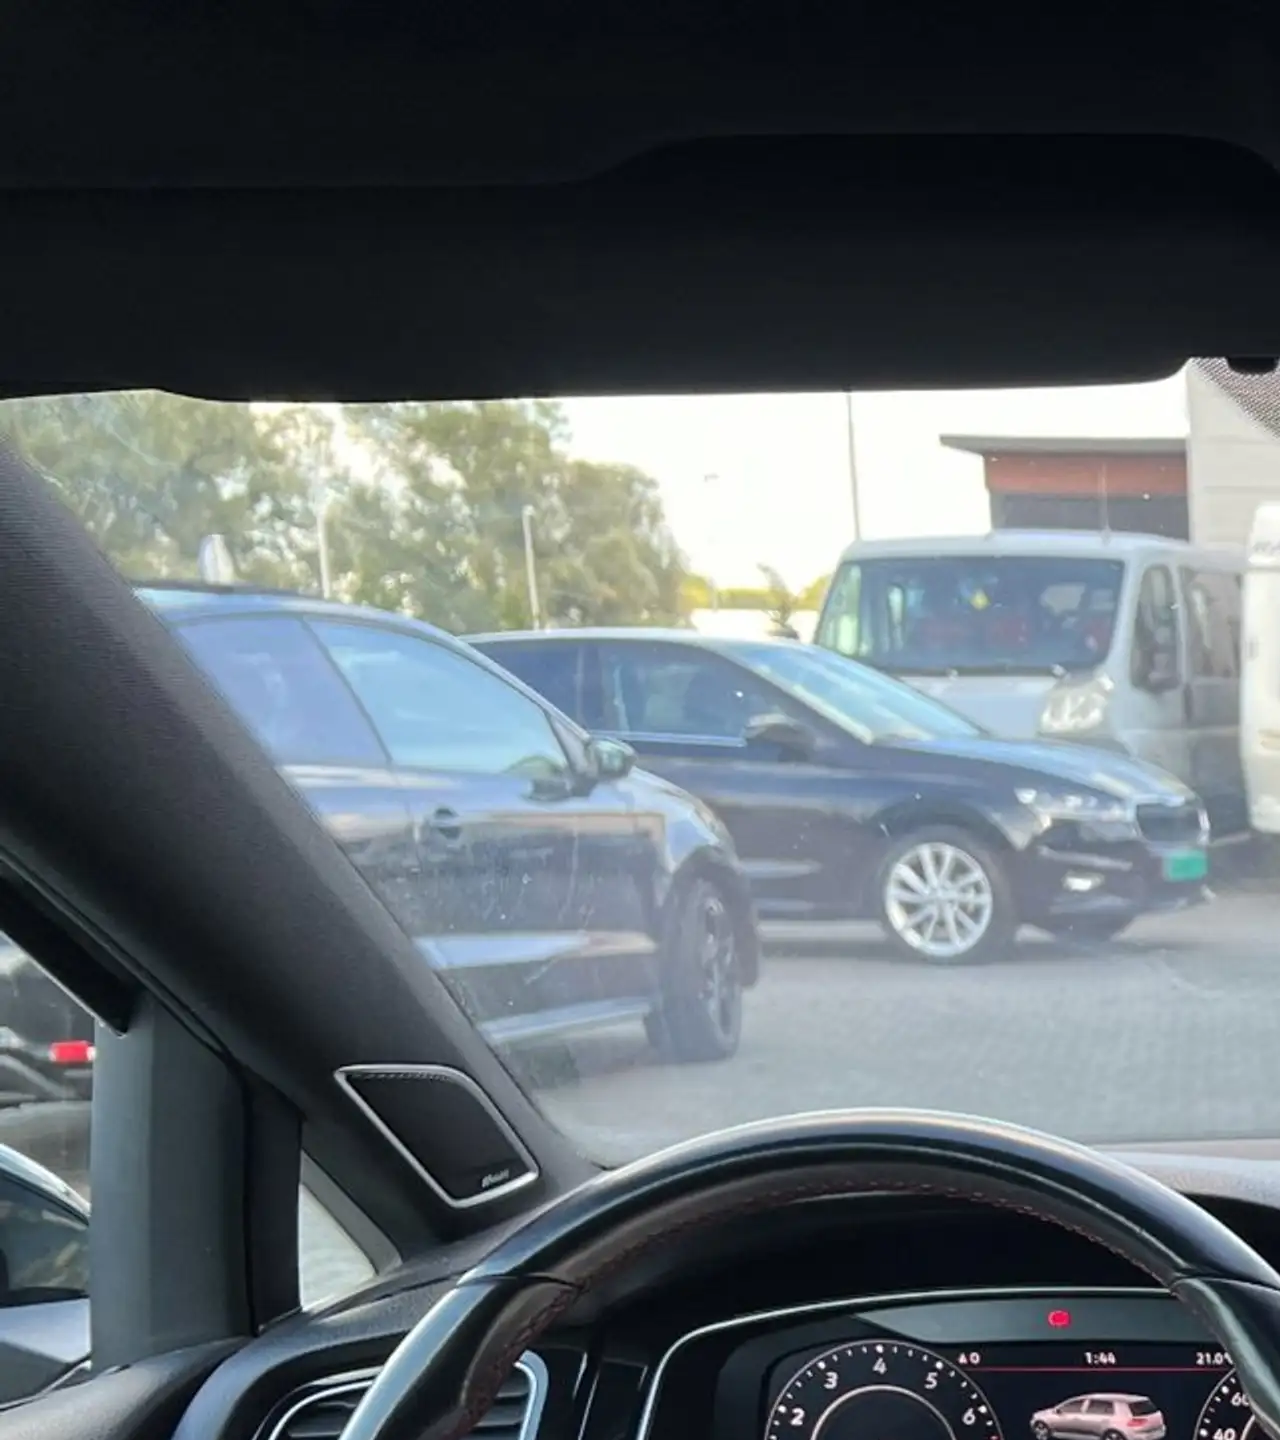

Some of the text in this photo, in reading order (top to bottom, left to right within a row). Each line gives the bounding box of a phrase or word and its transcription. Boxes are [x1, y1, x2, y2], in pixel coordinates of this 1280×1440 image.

[872, 1357, 888, 1375] 4
[1083, 1352, 1117, 1365] 1:44
[824, 1371, 839, 1390] 3
[924, 1372, 939, 1390] 5
[790, 1407, 806, 1427] 2
[961, 1407, 977, 1426] 6
